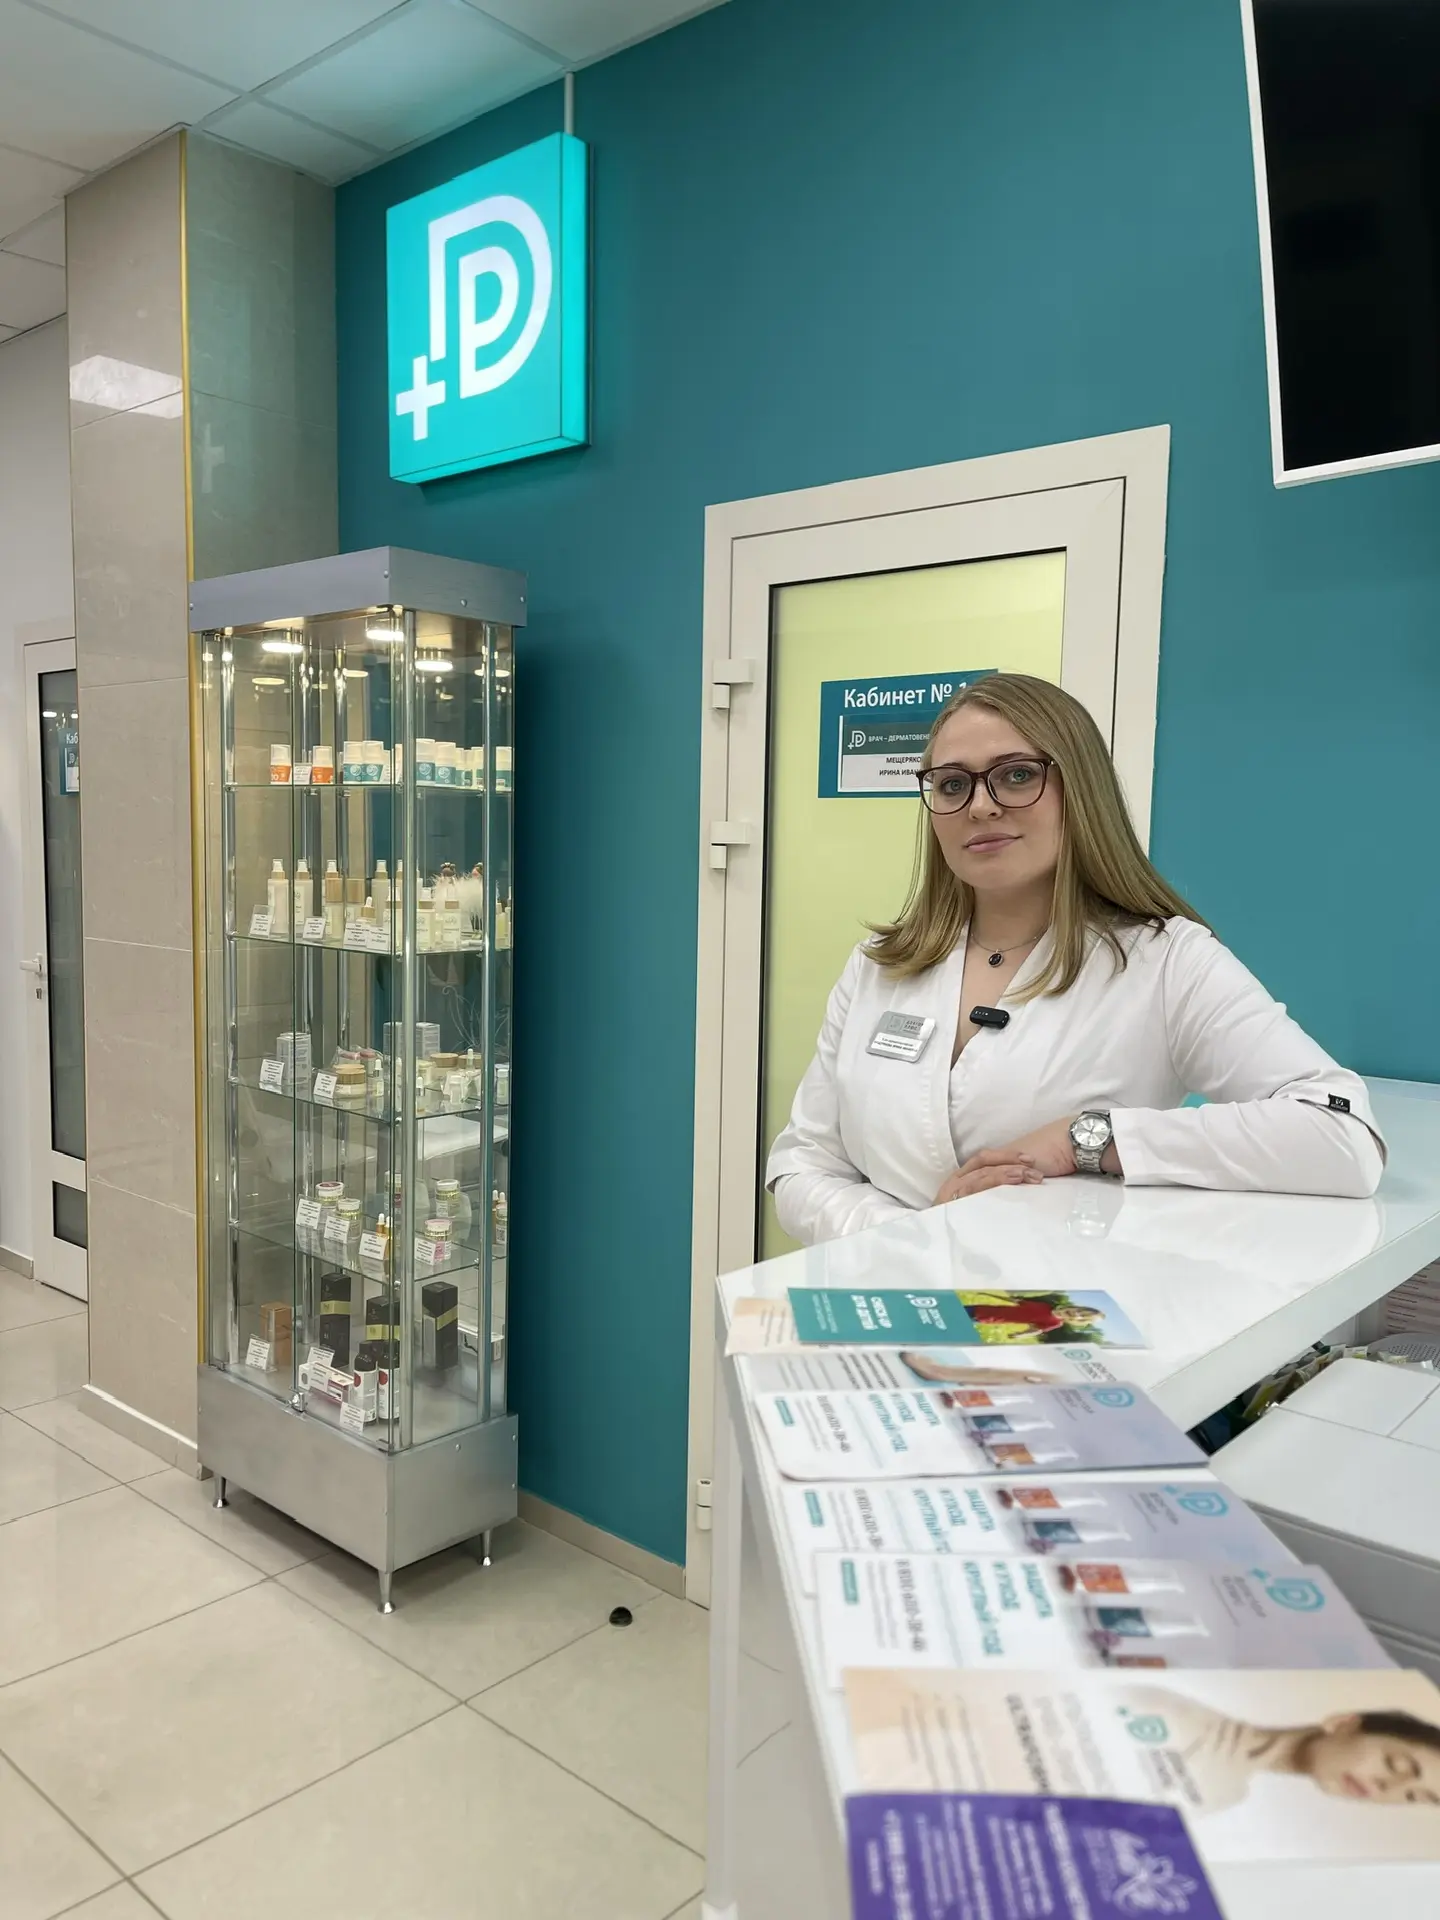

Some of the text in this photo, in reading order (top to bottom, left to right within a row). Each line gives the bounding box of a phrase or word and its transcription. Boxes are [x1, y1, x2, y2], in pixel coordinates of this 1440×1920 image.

[844, 683, 953, 708] Кабинет №
[868, 735, 884, 743] ВРАЧ
